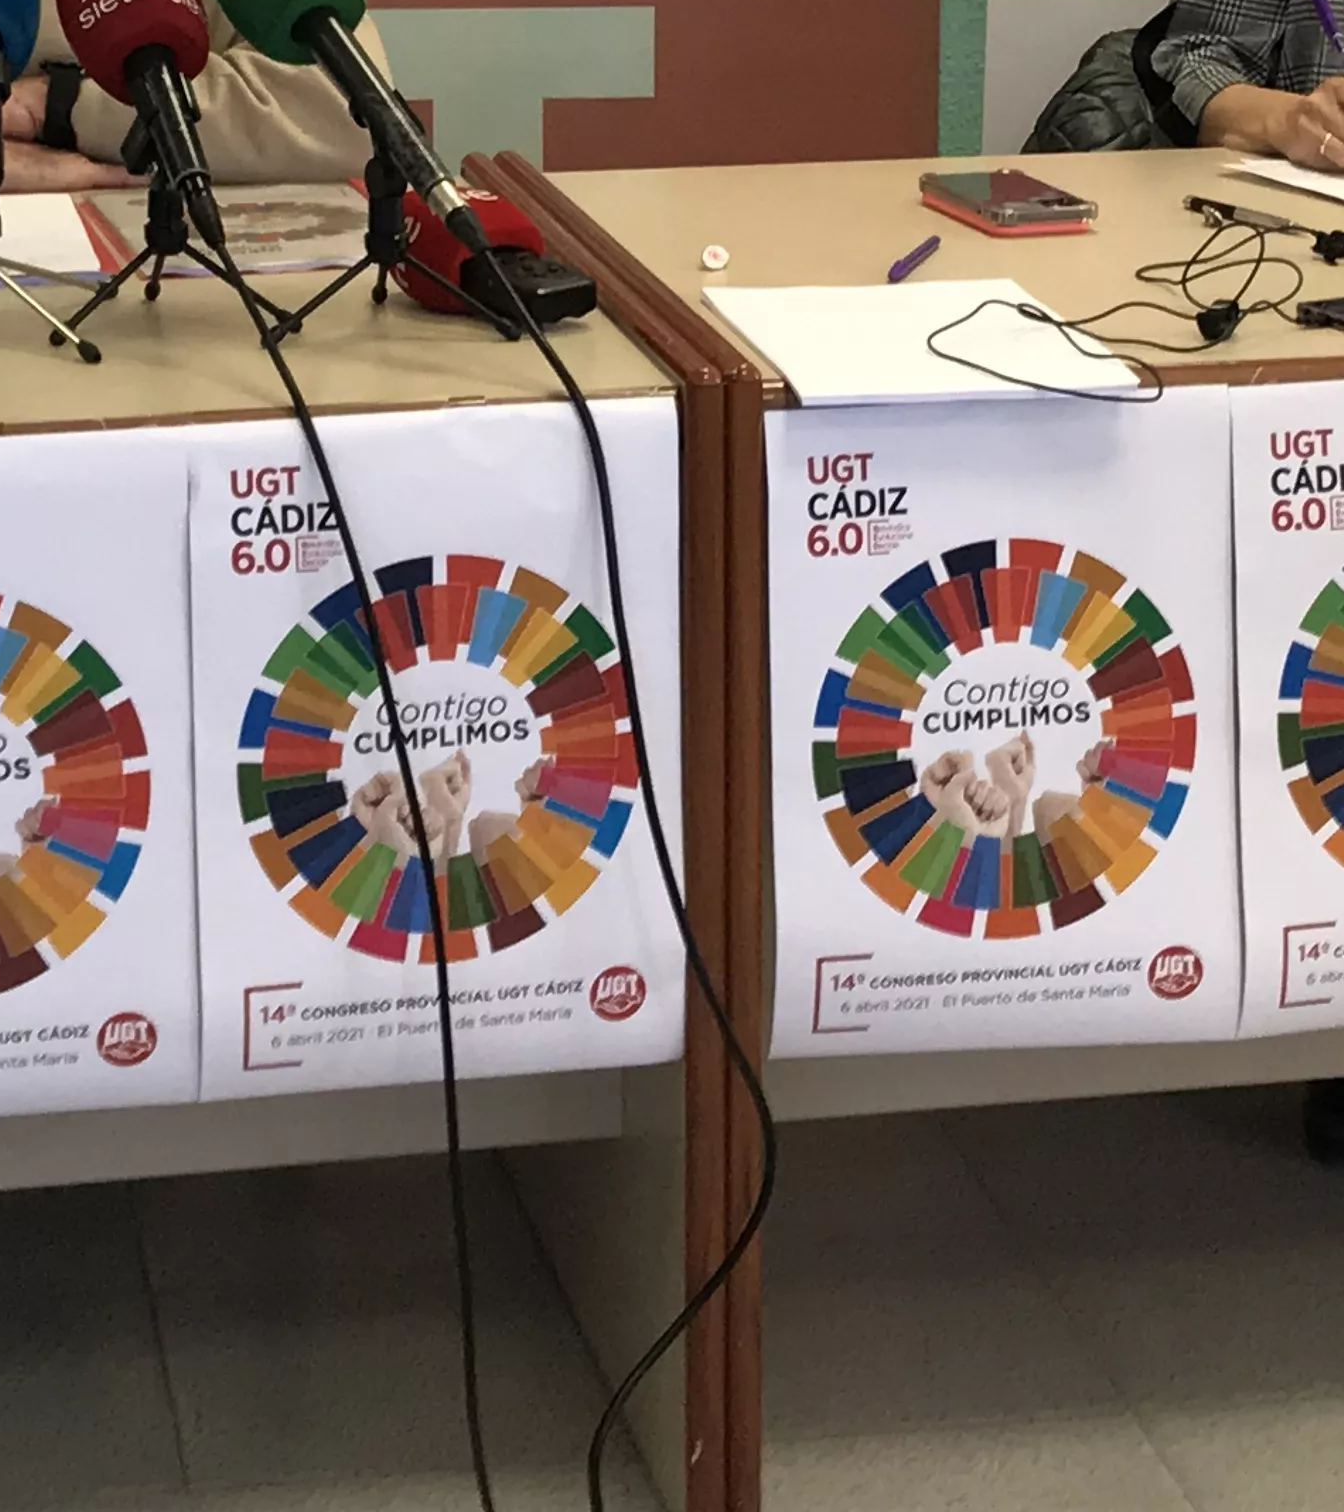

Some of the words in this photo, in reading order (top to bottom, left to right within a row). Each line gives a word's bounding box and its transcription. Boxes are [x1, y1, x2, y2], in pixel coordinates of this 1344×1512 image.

[1270, 429, 1333, 459] UGT
[230, 466, 301, 499] UGT
[807, 453, 873, 483] UGT
[231, 497, 340, 537] CÁDIZ
[808, 485, 907, 520] CÁDIZ
[1272, 497, 1326, 530] 6.0
[231, 537, 291, 575] 6.0
[807, 523, 862, 556] 6.0
[944, 675, 1069, 708] Contigo
[376, 693, 508, 725] Contigo
[923, 701, 1091, 734] CUMPLIMOS
[354, 719, 529, 754] CUMPLIMOS
[869, 973, 957, 989] CONGRESO
[961, 965, 1055, 983] PROVINCIAL
[1059, 962, 1091, 978] UGT
[1094, 957, 1142, 974] CÁDIZ
[893, 997, 930, 1010] 2021
[962, 991, 1011, 1006] Puerto
[1041, 988, 1083, 1001] Santa
[0, 1030, 33, 1045] UGT
[37, 1023, 90, 1042] CÁDIZ
